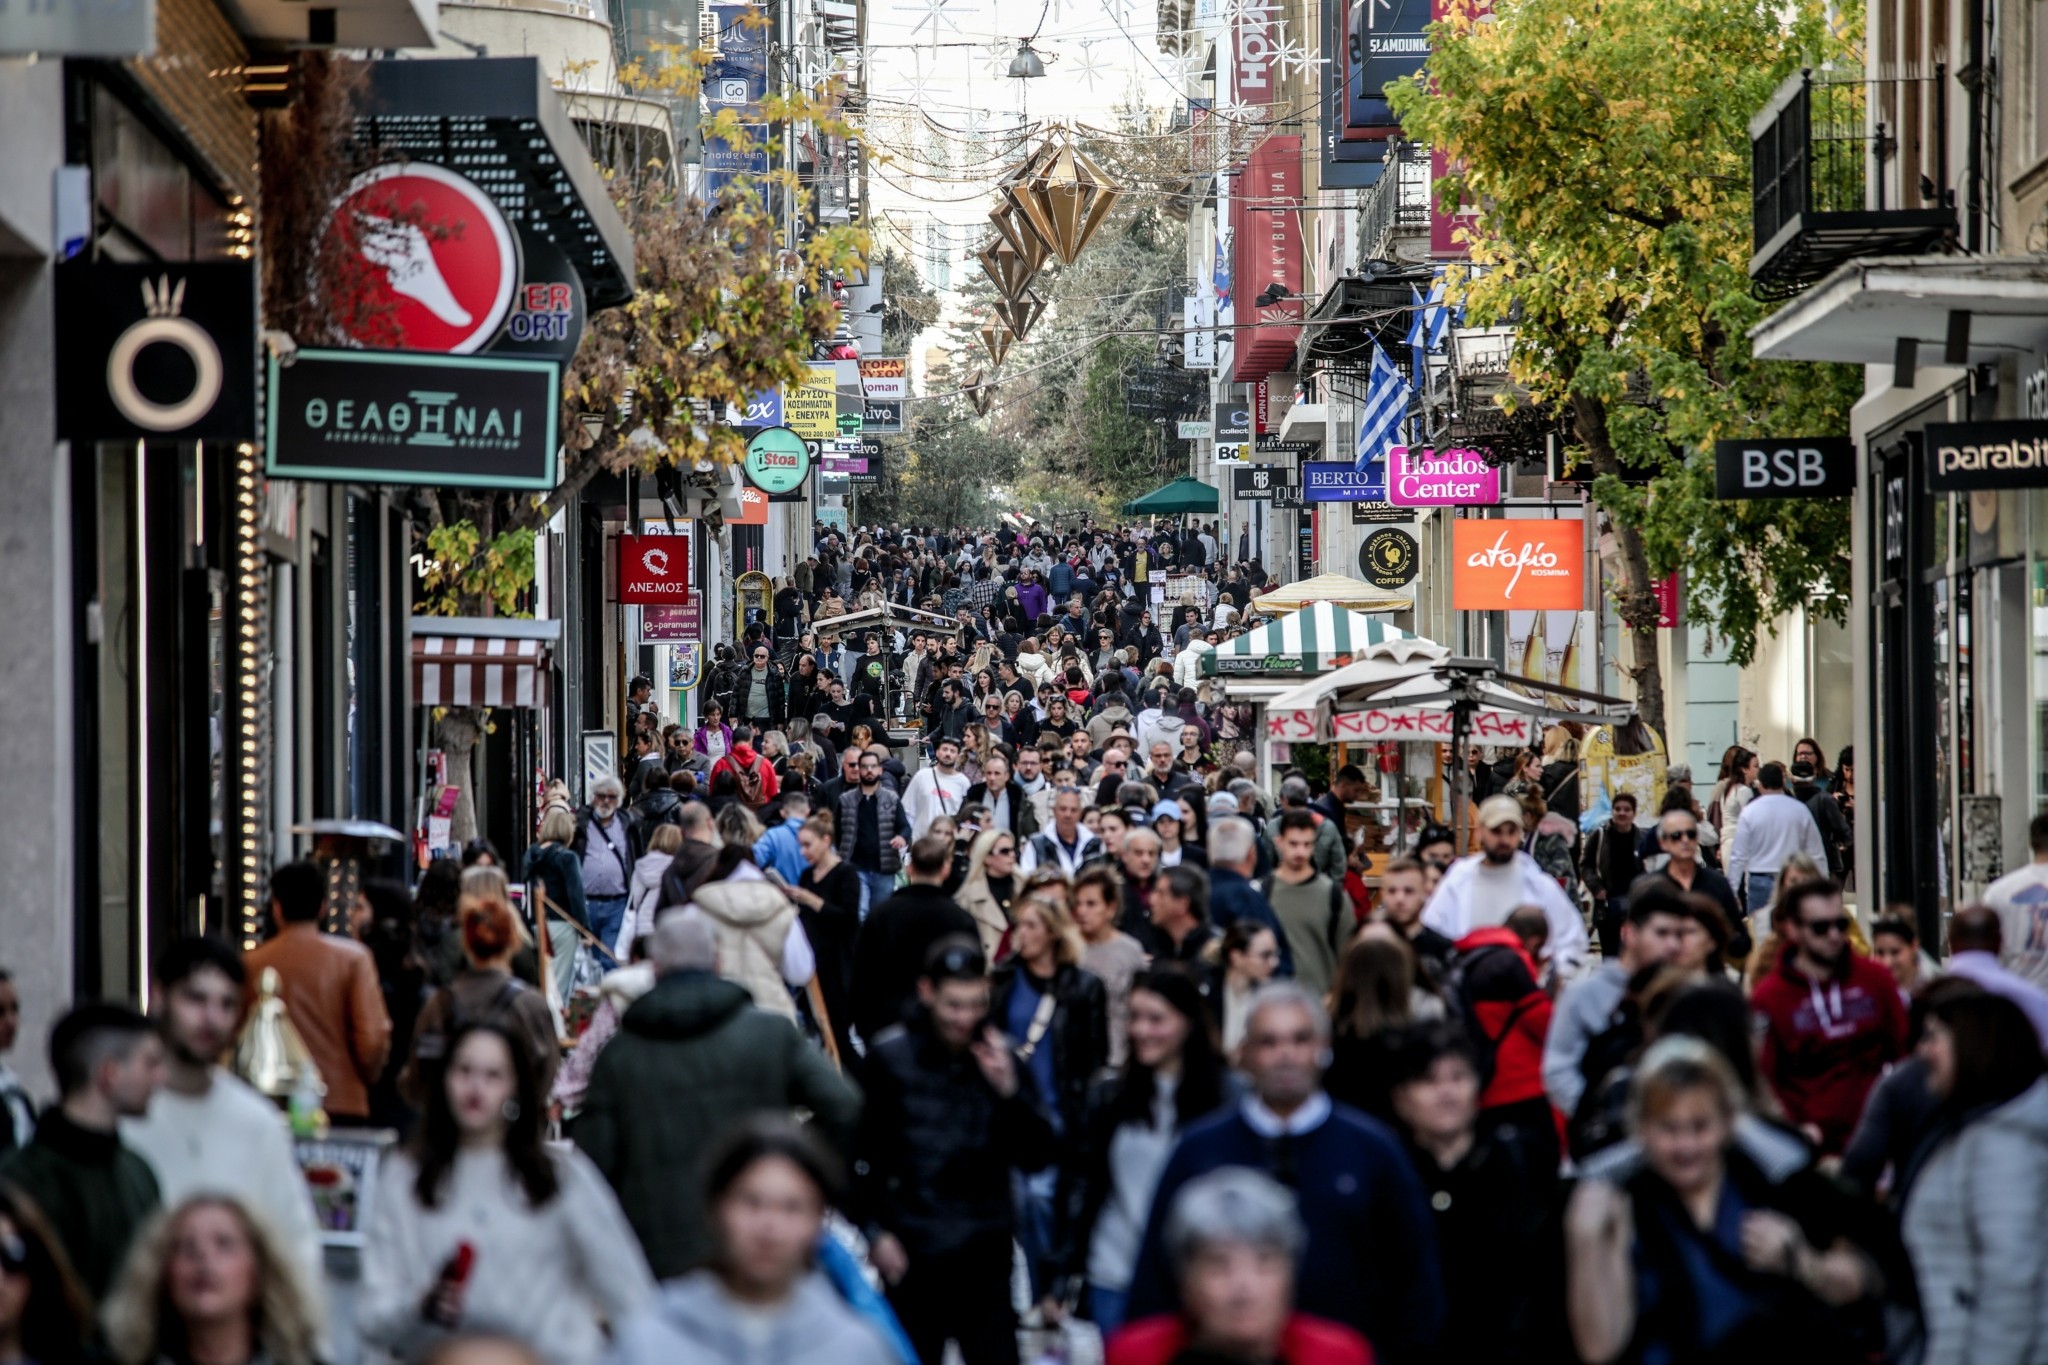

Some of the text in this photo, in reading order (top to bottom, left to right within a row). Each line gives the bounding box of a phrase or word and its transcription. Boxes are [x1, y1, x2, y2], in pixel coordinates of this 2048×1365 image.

[724, 83, 744, 97] Go
[708, 151, 763, 160] nordgreen
[794, 389, 830, 399] ΧΡΥΣΟΥ
[1270, 395, 1295, 403] ecco
[787, 400, 833, 409] ΚΟΣΜΗΜΑΤΩΝ
[795, 410, 830, 420] ΕΝΕΧΥΡΑ
[758, 452, 796, 466] iStoa
[1398, 453, 1490, 476] Hondos
[1742, 448, 1826, 488] BSB
[1311, 471, 1369, 485] BERTO
[1399, 475, 1481, 499] Center
[1530, 569, 1570, 577] KOSMIMA
[1375, 577, 1406, 585] COFFEE
[628, 582, 684, 594] ΑΝΕΜΟΣ
[643, 621, 698, 633] e-paramana
[1217, 655, 1301, 670] ERMOU Flower
